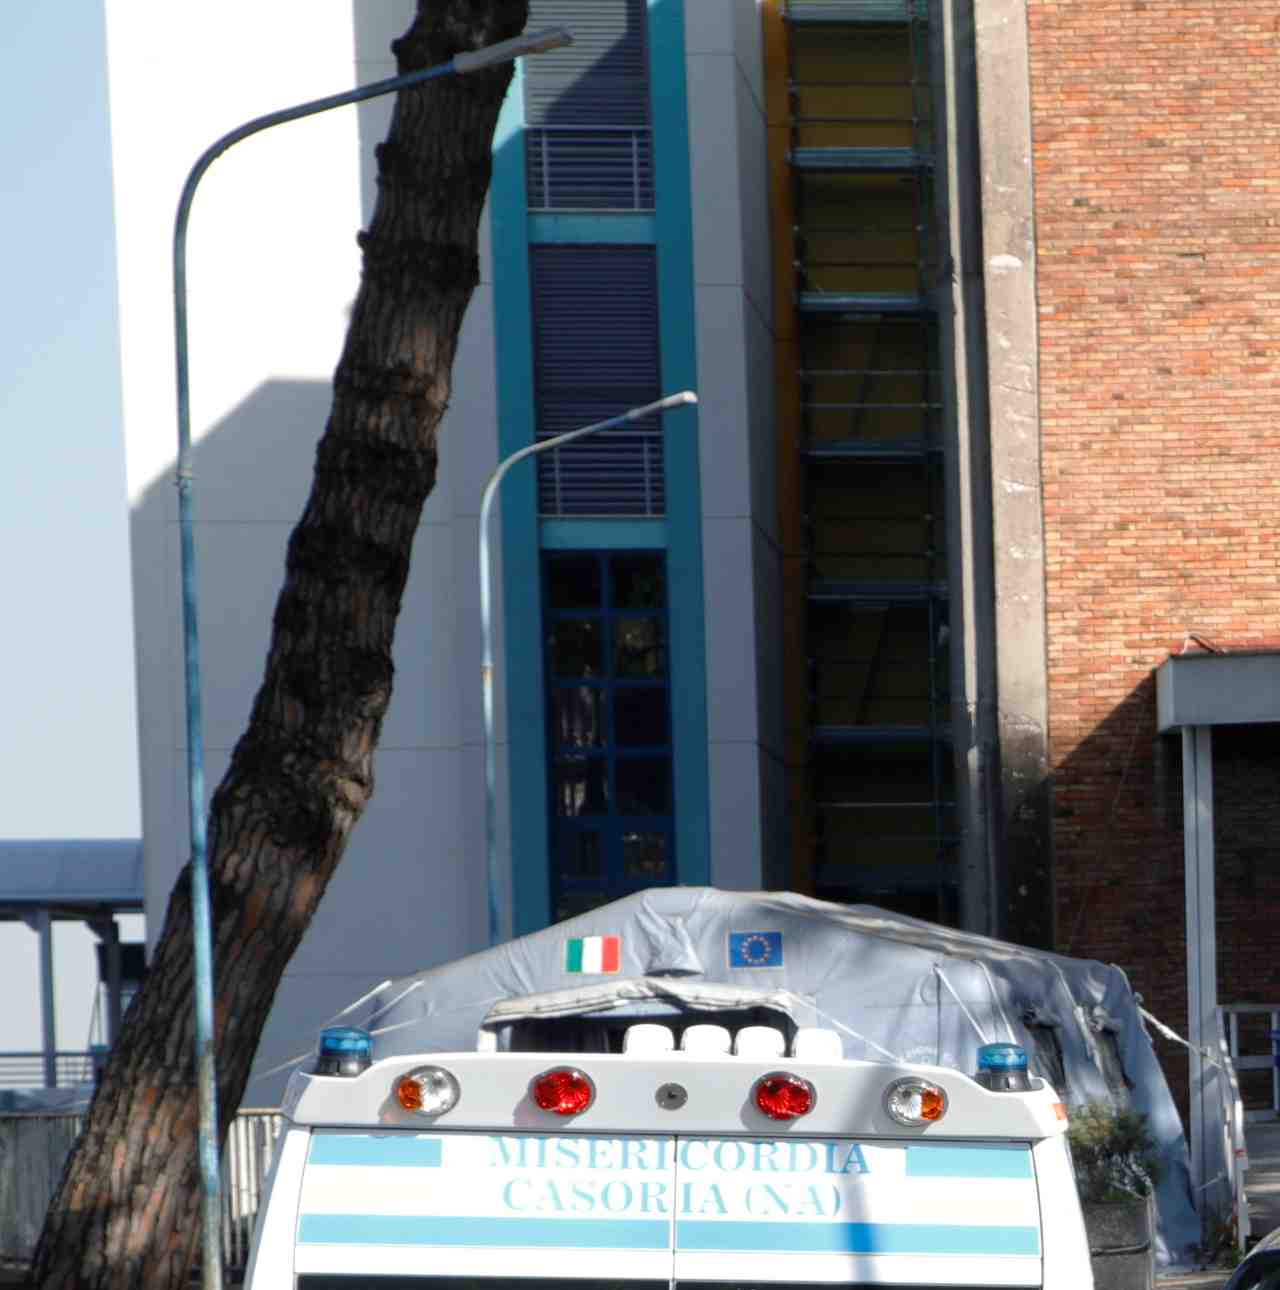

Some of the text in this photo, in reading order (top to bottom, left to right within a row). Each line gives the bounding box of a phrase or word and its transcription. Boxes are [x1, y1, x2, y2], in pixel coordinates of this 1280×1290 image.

[488, 1135, 872, 1174] MISERICORDIA
[502, 1177, 842, 1217] CASORIA (NA)
